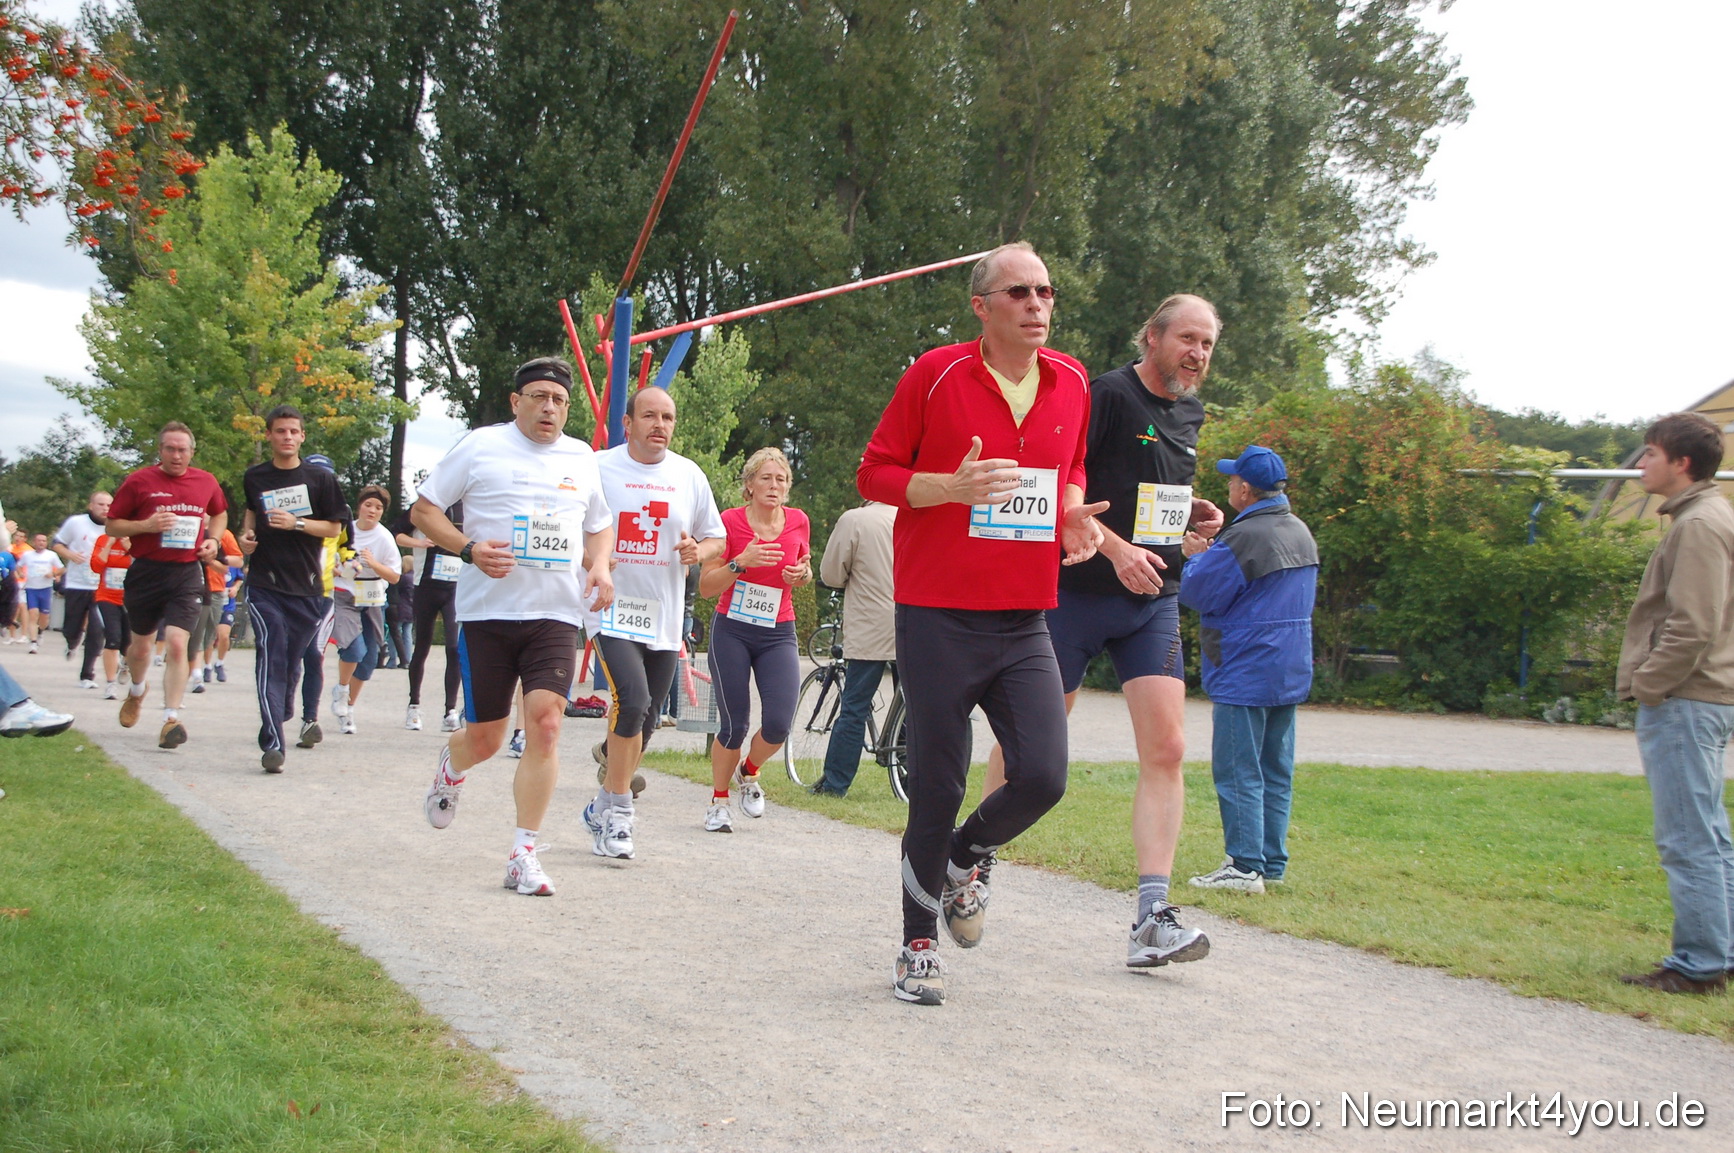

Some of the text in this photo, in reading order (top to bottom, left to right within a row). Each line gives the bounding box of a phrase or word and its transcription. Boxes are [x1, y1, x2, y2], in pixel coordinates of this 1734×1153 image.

[625, 483, 676, 492] www.dkms.de
[277, 494, 302, 508] 2947
[999, 496, 1048, 515] 2070
[1161, 509, 1184, 526] 788
[532, 520, 560, 532] Michael
[532, 535, 568, 552] 3424
[618, 540, 656, 554] DKMS
[442, 564, 460, 574] 3491
[630, 558, 655, 566] EINZELNE
[617, 599, 647, 612] Gerhard
[745, 598, 775, 613] 3465
[618, 613, 652, 629] 2486
